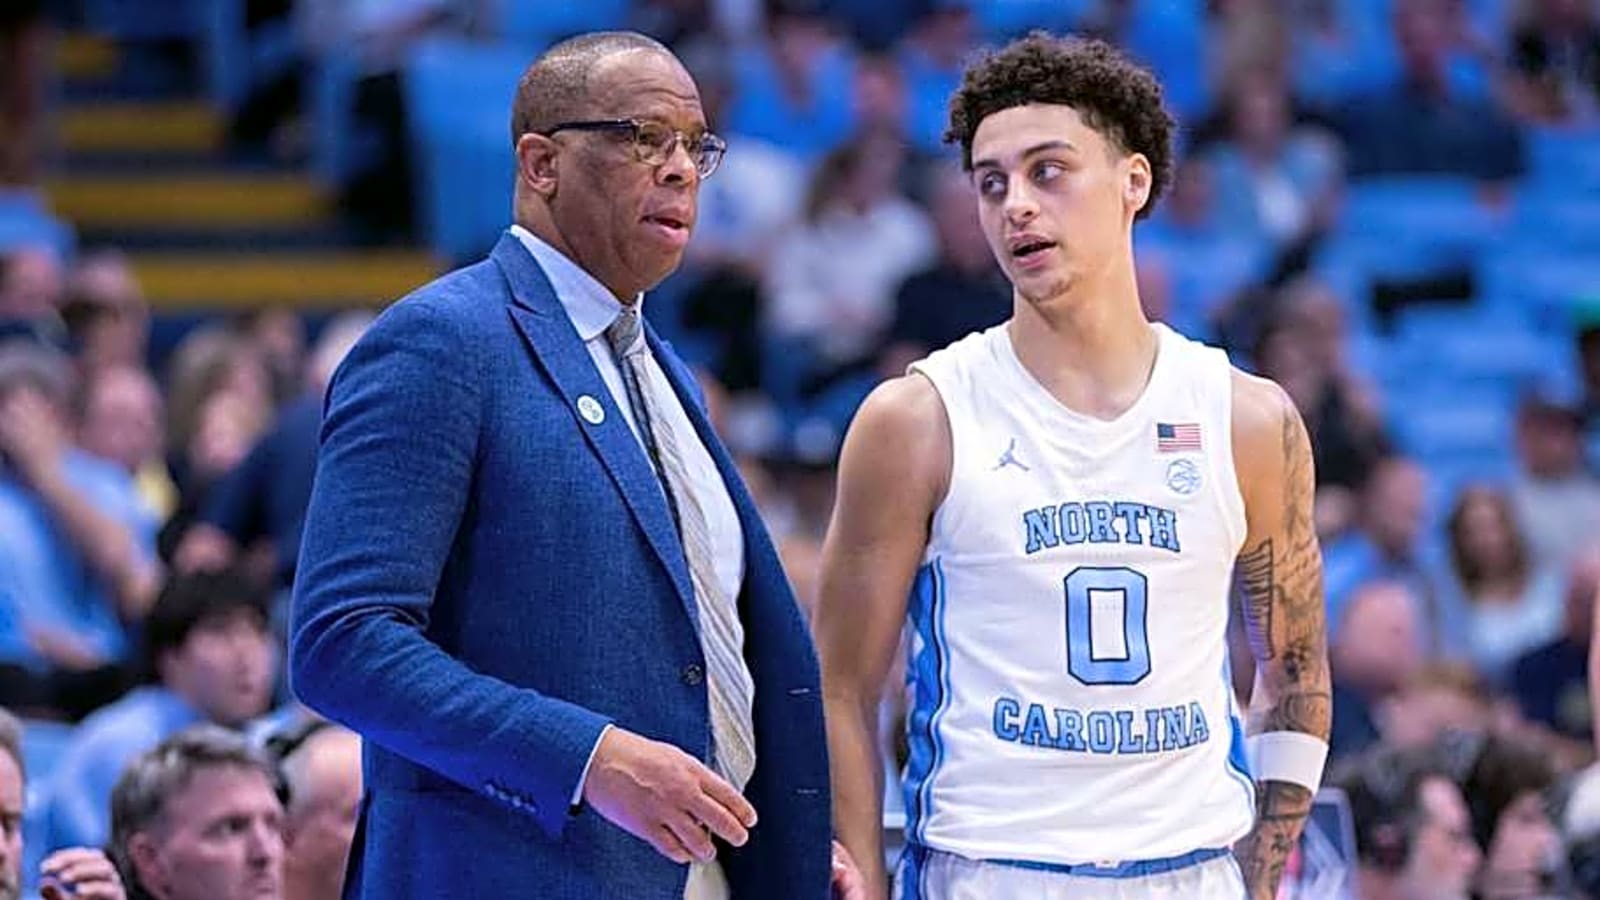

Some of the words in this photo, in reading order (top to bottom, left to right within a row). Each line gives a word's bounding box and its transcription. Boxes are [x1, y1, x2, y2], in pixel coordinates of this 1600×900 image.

[1024, 502, 1181, 554] NORTH
[1064, 566, 1151, 685] 0
[994, 697, 1209, 754] CAROLINA
